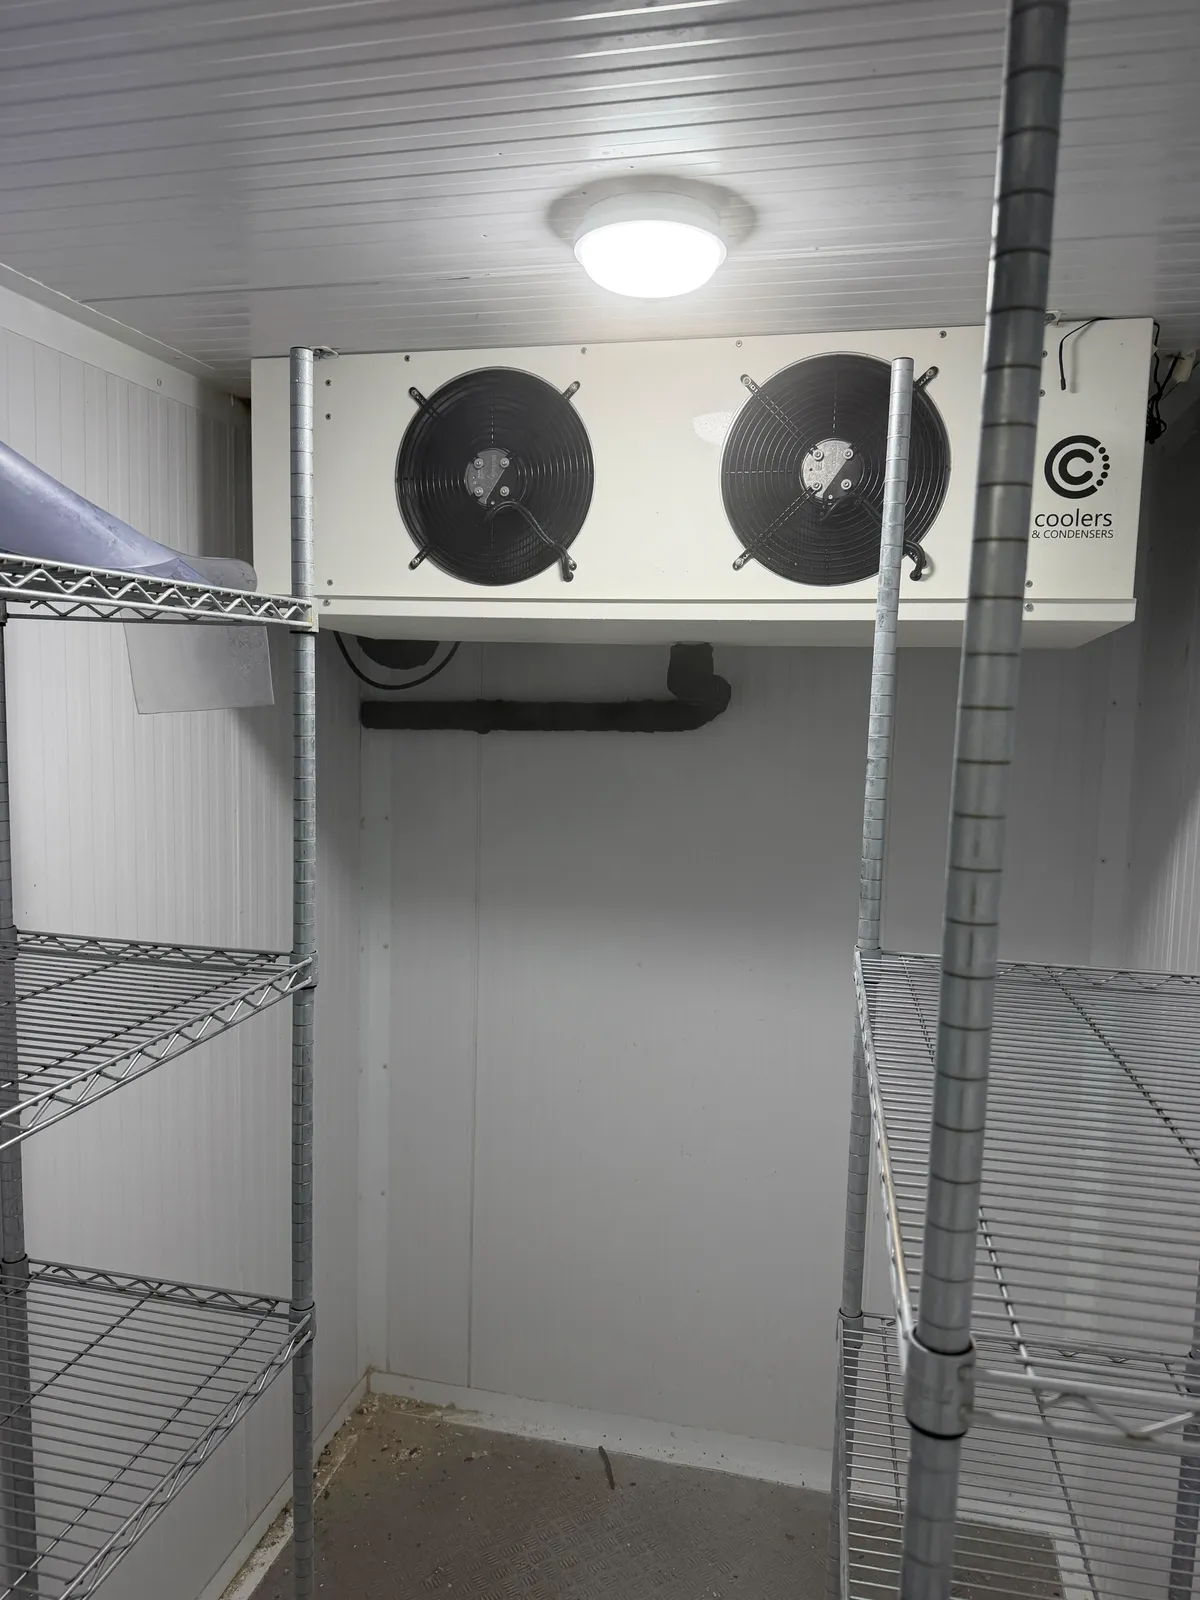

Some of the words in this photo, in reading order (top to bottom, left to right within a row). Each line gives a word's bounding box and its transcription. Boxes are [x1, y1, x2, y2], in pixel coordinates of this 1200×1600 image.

[1034, 508, 1113, 527] coolers
[1031, 529, 1041, 539] &
[1043, 529, 1114, 539] CONDENSERS
